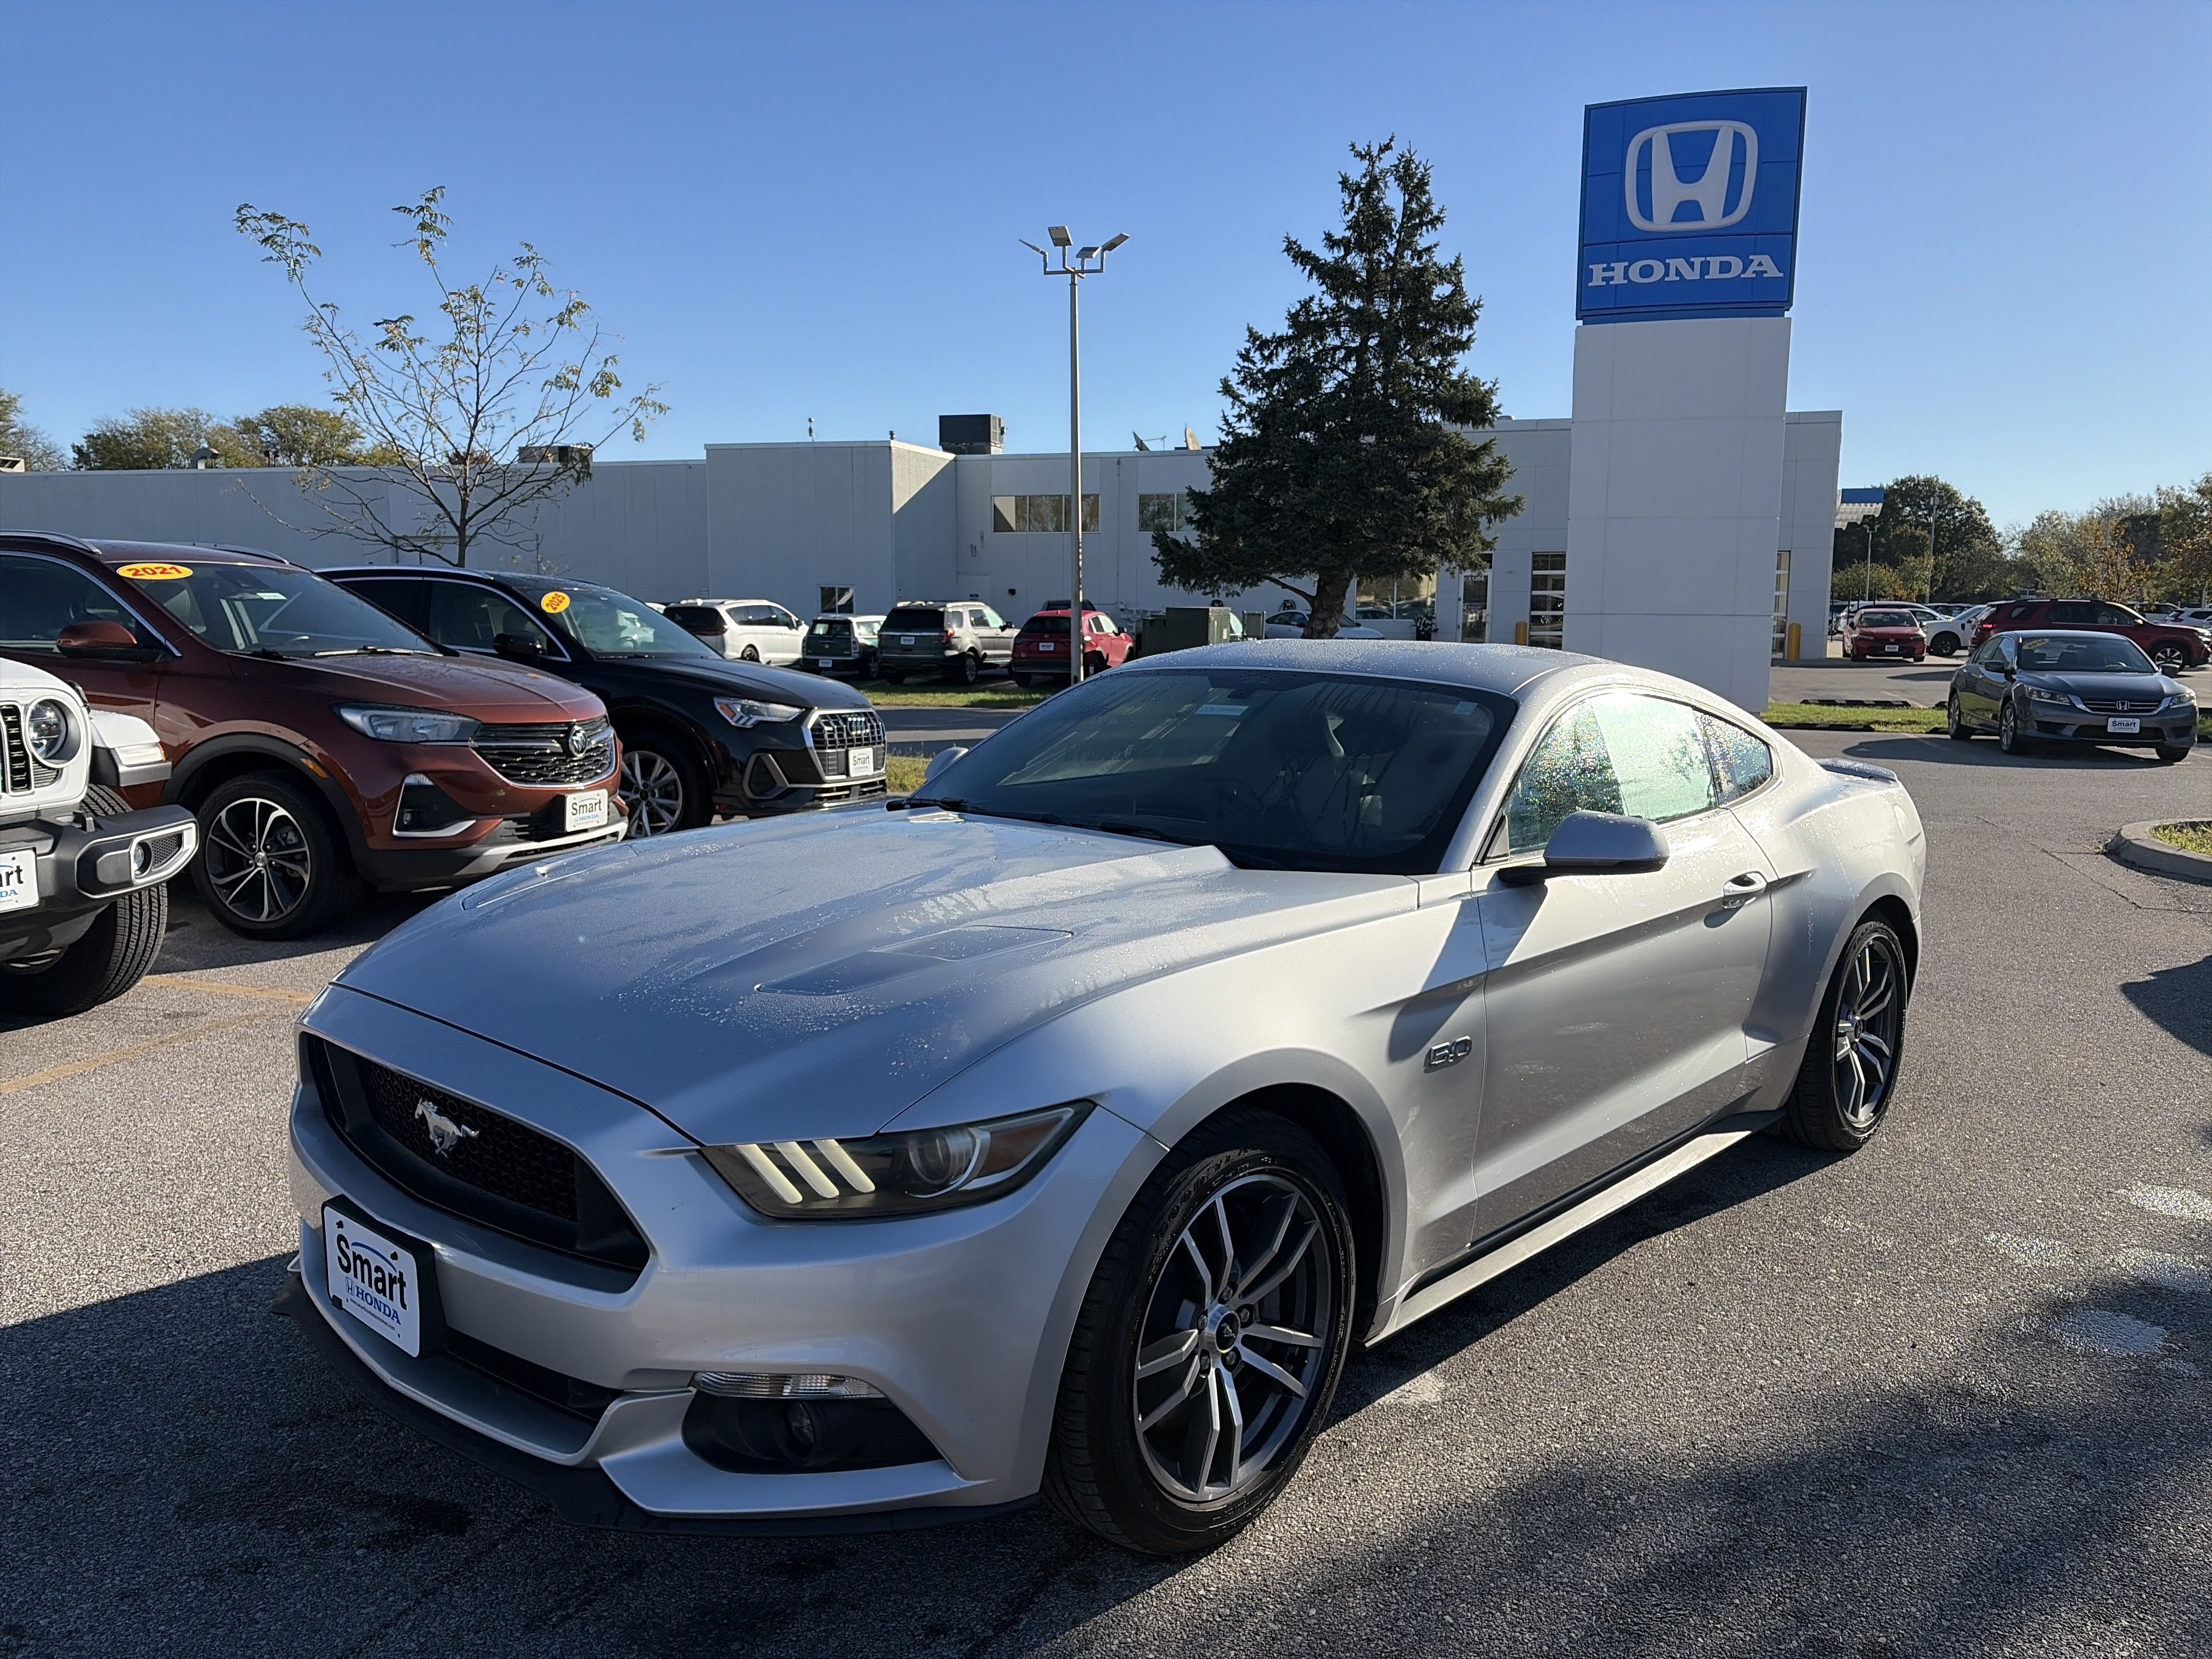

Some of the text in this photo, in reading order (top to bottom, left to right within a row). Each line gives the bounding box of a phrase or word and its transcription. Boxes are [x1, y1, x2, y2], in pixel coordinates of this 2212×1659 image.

[1588, 255, 1784, 286] HONDA
[127, 566, 182, 577] 2021
[545, 593, 566, 611] 2025
[853, 755, 870, 766] Smart
[571, 798, 602, 816] Smart
[1430, 1036, 1472, 1066] 5.0
[336, 1233, 407, 1311] Smart
[355, 1285, 402, 1325] HONDA
